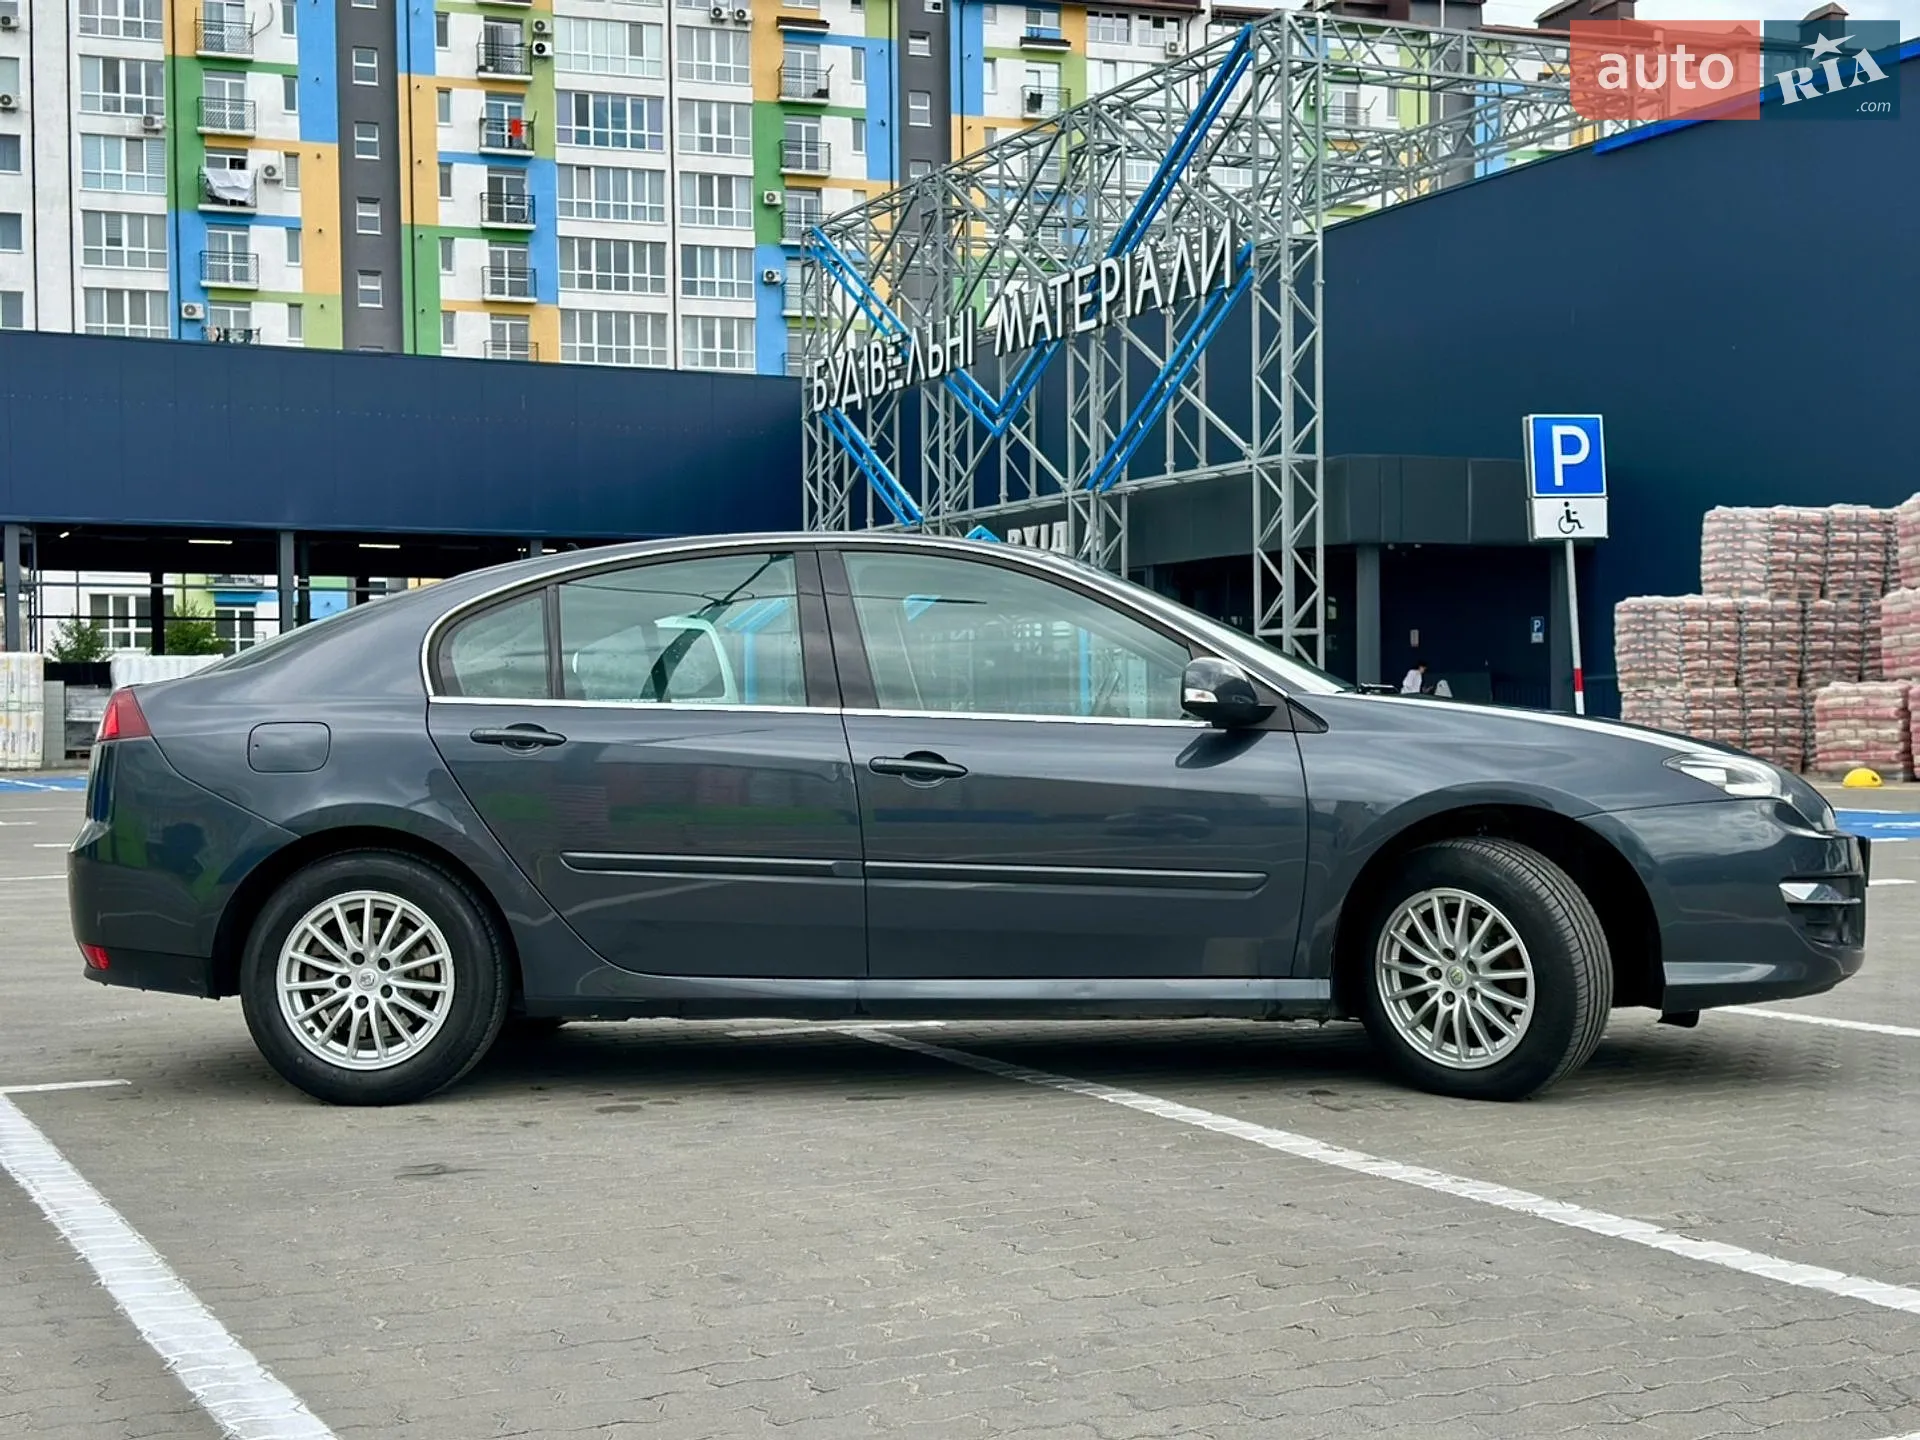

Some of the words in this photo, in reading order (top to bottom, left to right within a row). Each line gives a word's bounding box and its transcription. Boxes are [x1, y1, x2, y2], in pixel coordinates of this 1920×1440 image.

[813, 306, 975, 412] БУДІВЕЛЬНІ
[995, 218, 1234, 357] МАТЕРІАЛИ
[1551, 424, 1591, 487] P
[1533, 619, 1542, 633] P
